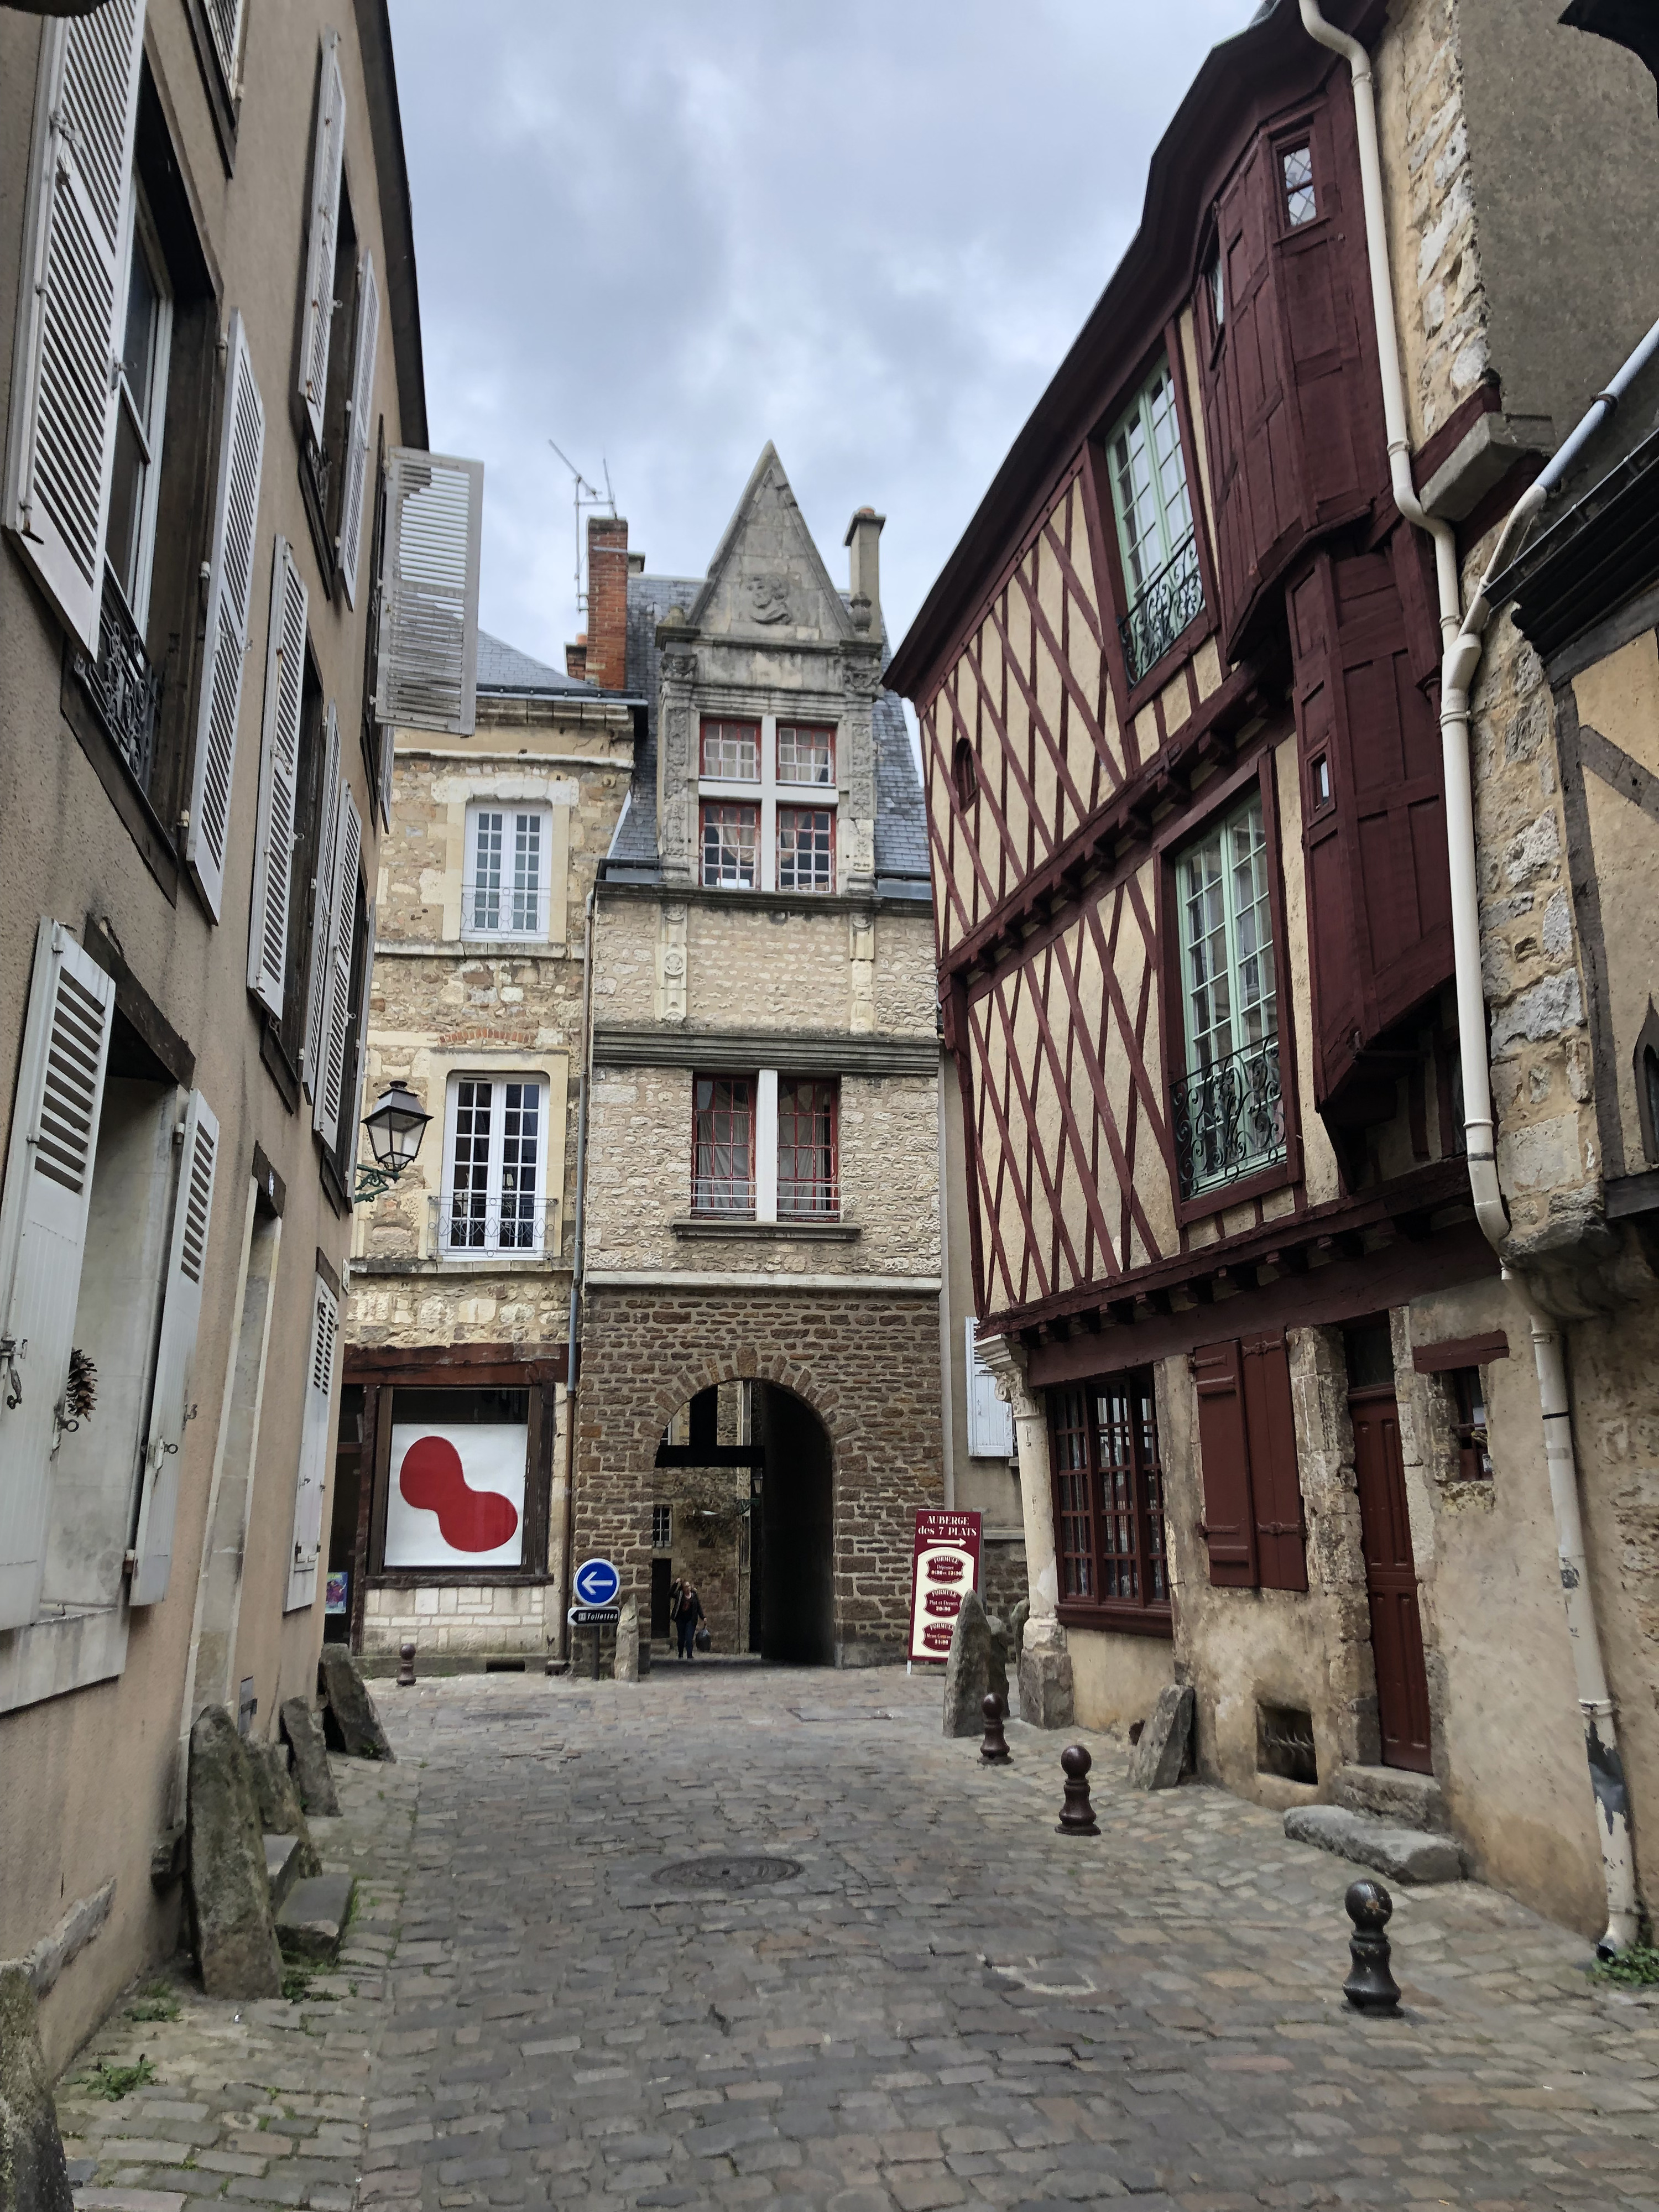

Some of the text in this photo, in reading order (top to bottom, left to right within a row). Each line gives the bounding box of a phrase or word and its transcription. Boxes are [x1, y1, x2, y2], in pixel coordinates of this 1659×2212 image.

[927, 1515, 969, 1525] AUBERGE
[918, 1525, 977, 1536] des 7 PLATS
[933, 1556, 959, 1564] FORMULE
[932, 1589, 957, 1598] FORMULE
[930, 1623, 954, 1631] FORMULE
